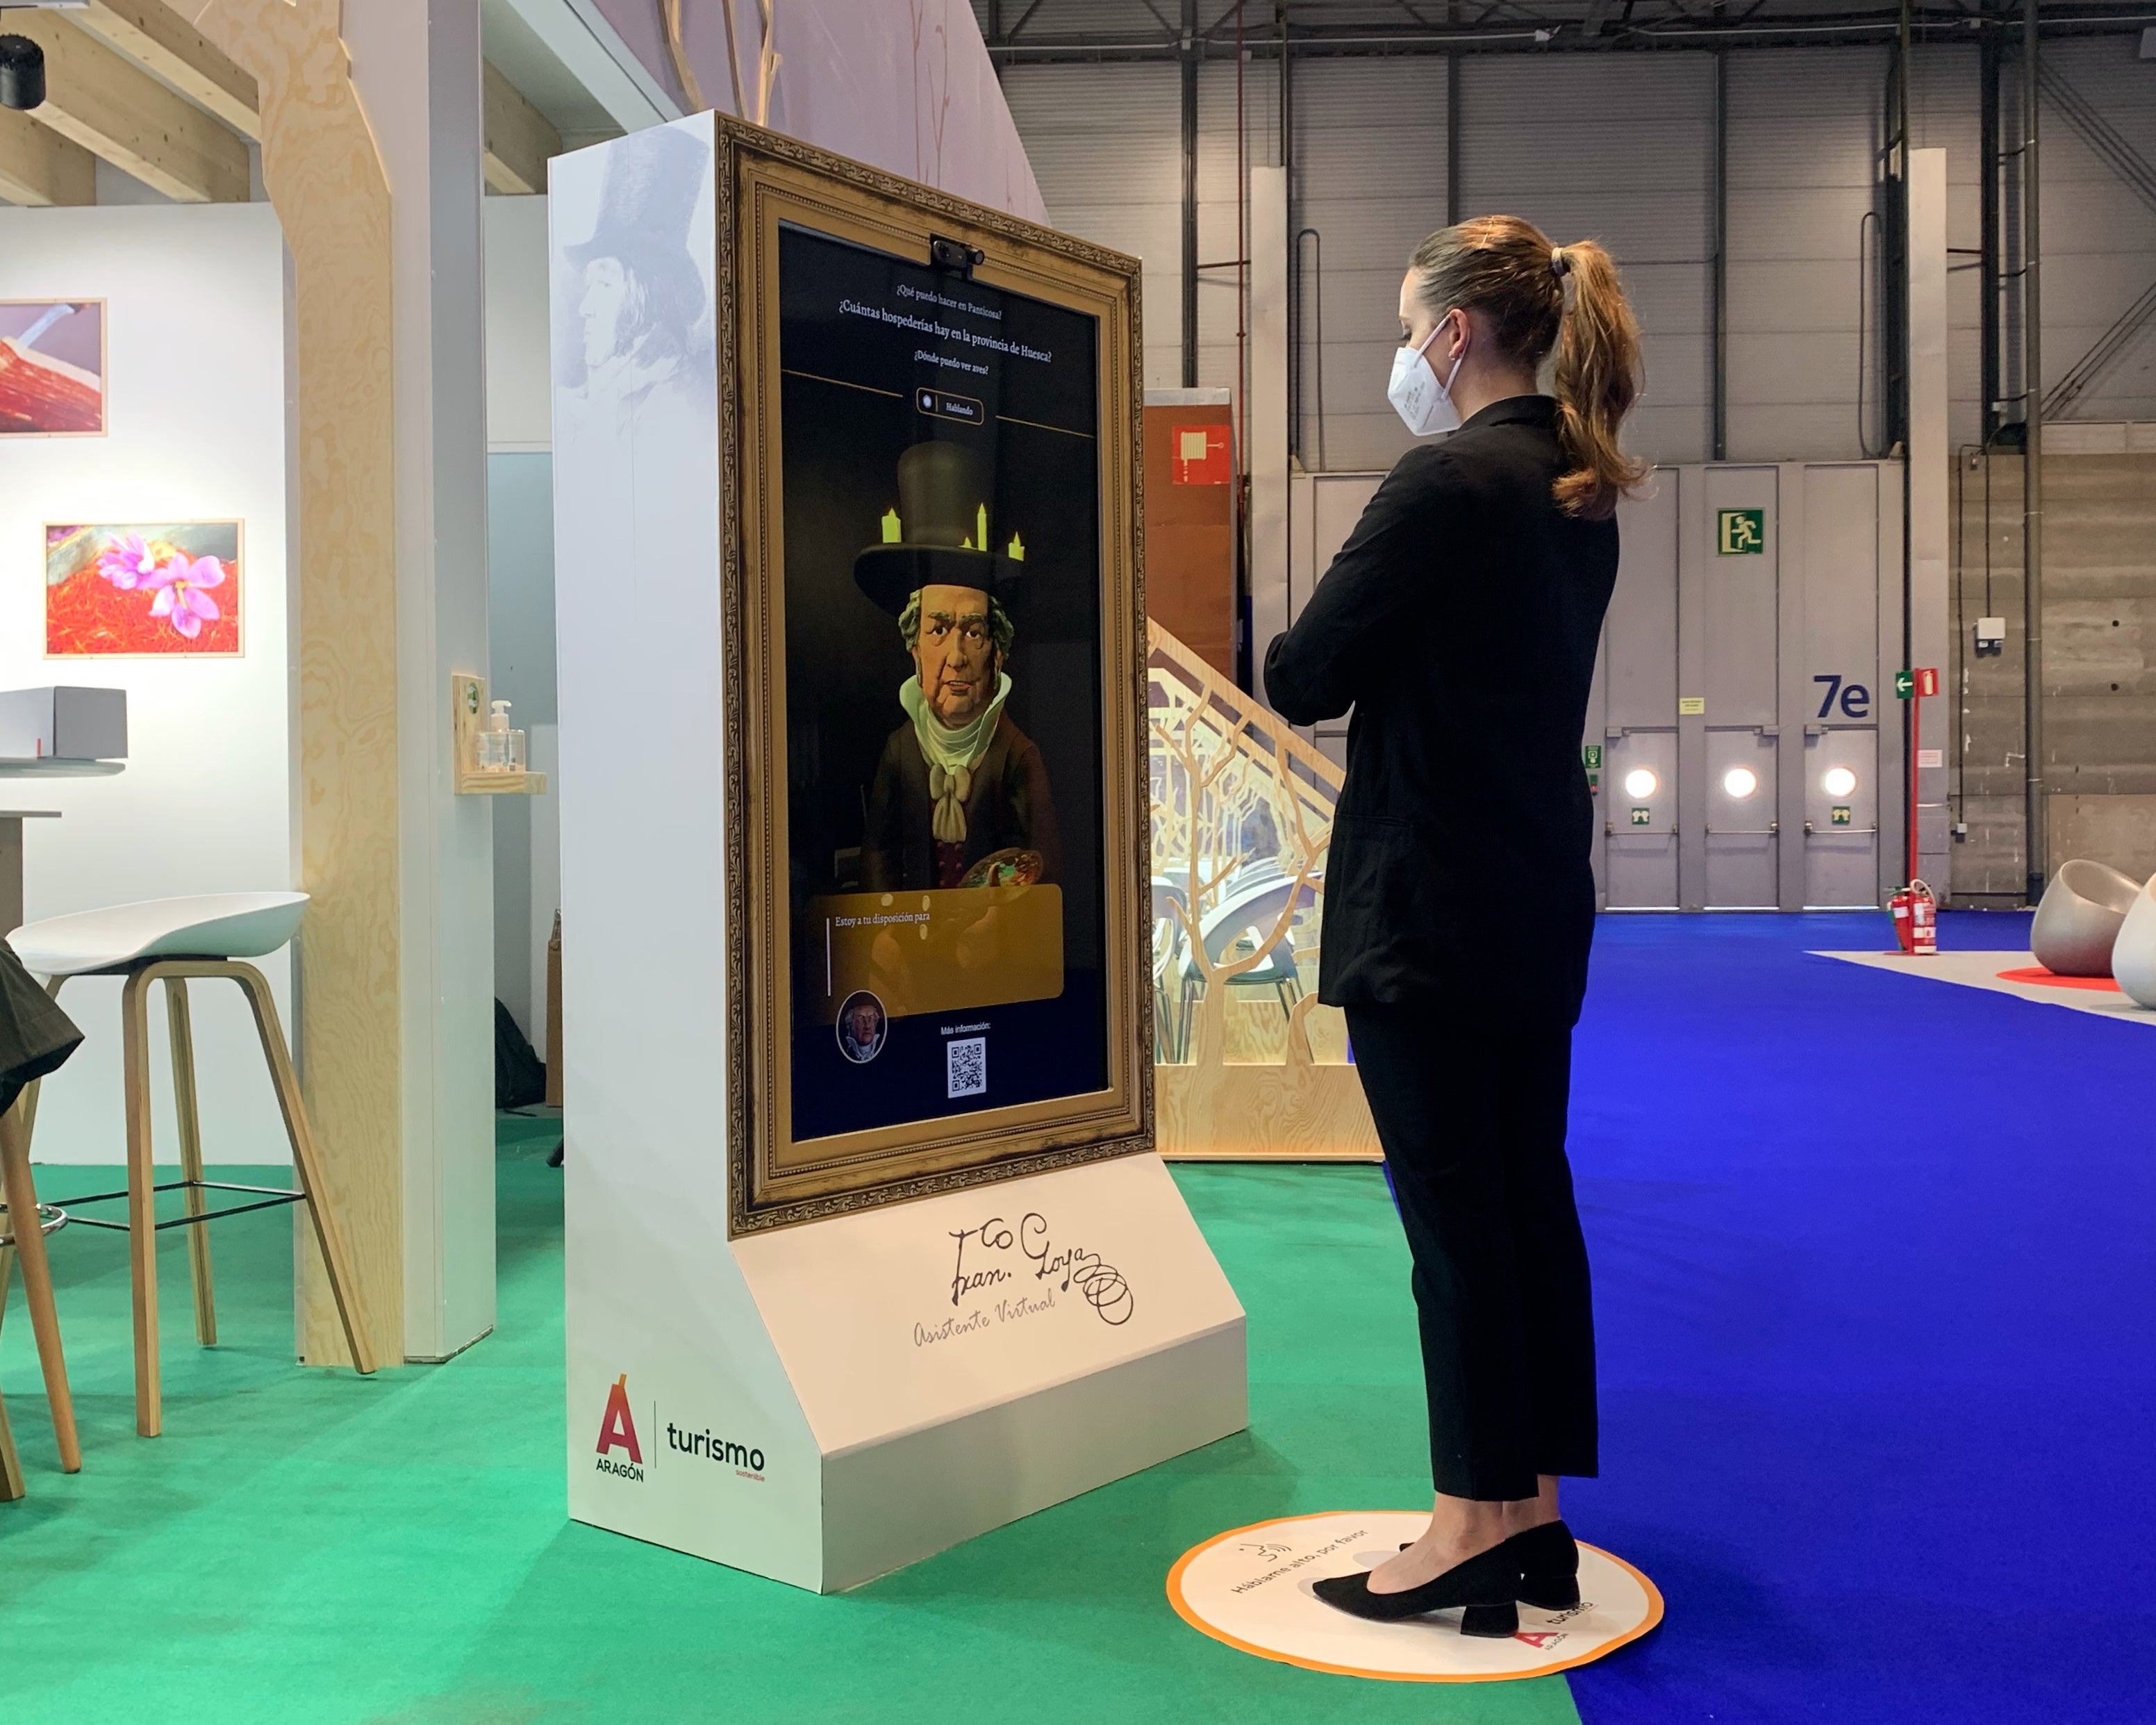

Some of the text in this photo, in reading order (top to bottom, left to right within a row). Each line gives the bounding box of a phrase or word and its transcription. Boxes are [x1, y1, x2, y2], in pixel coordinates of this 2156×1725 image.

[897, 284, 1002, 320] ¿Qué puedo hacer en Panticosa?
[839, 299, 1052, 363] ¿Cuántas hospederías hay en la provincia de Huesca?
[914, 349, 989, 375] ¿Dónde puedo ver aves?
[945, 402, 974, 416] Hablando
[1814, 675, 1870, 718] 7e
[835, 911, 931, 929] Estoy a tu disposición para
[940, 1021, 991, 1035] Más información:
[913, 1287, 1056, 1347] Asistente Virtual
[667, 1423, 765, 1471] turismo
[596, 1458, 644, 1483] ARAGÓN
[736, 1469, 765, 1483] sostenible
[1230, 1528, 1369, 1594] Háblame alto, por favor
[1545, 1601, 1593, 1625] turismo
